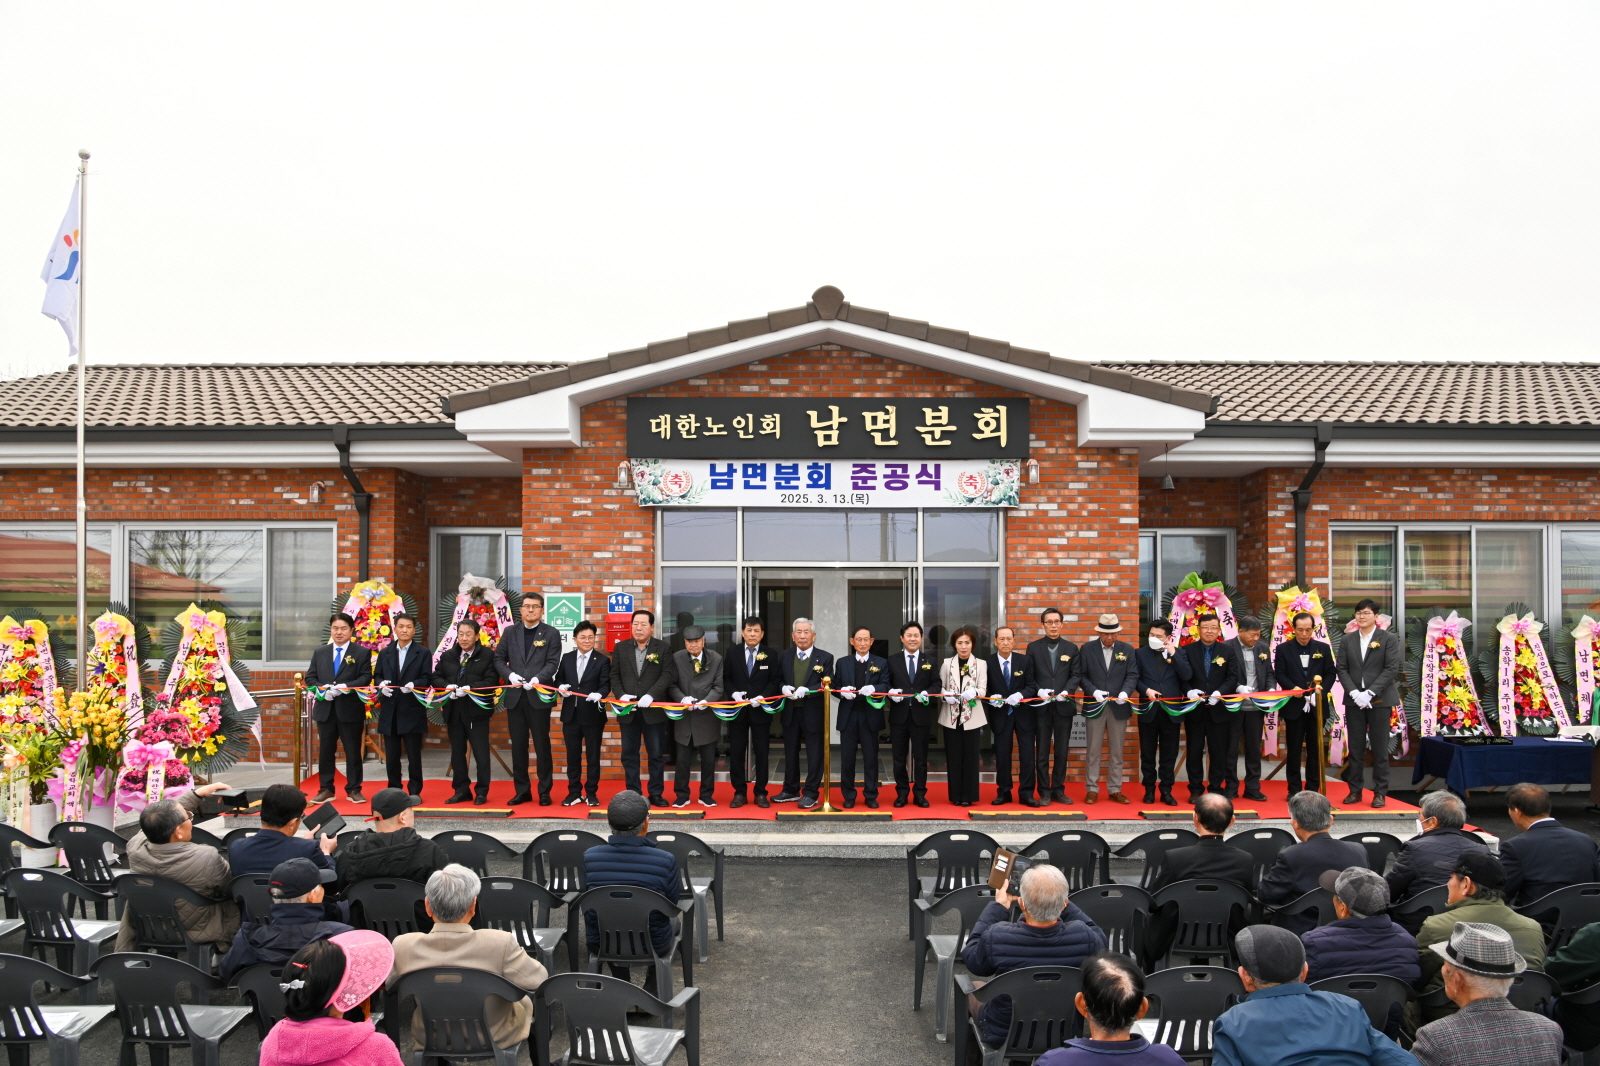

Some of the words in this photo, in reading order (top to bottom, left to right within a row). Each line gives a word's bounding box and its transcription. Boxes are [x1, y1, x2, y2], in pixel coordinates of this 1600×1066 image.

[649, 413, 782, 440] 대한노인회
[806, 405, 1008, 448] 남면분회
[669, 474, 684, 489] 축
[709, 462, 832, 491] 남면분회
[850, 463, 941, 491] 준공식
[963, 474, 980, 490] 축
[780, 493, 813, 504] 2025.
[817, 494, 828, 504] 3.
[833, 493, 870, 505] 13.(목)
[609, 595, 630, 605] 416
[1222, 611, 1233, 628] 축
[1534, 643, 1552, 679] 진심으로
[1547, 682, 1569, 726] 축하드립니
[1501, 693, 1511, 714] 주민
